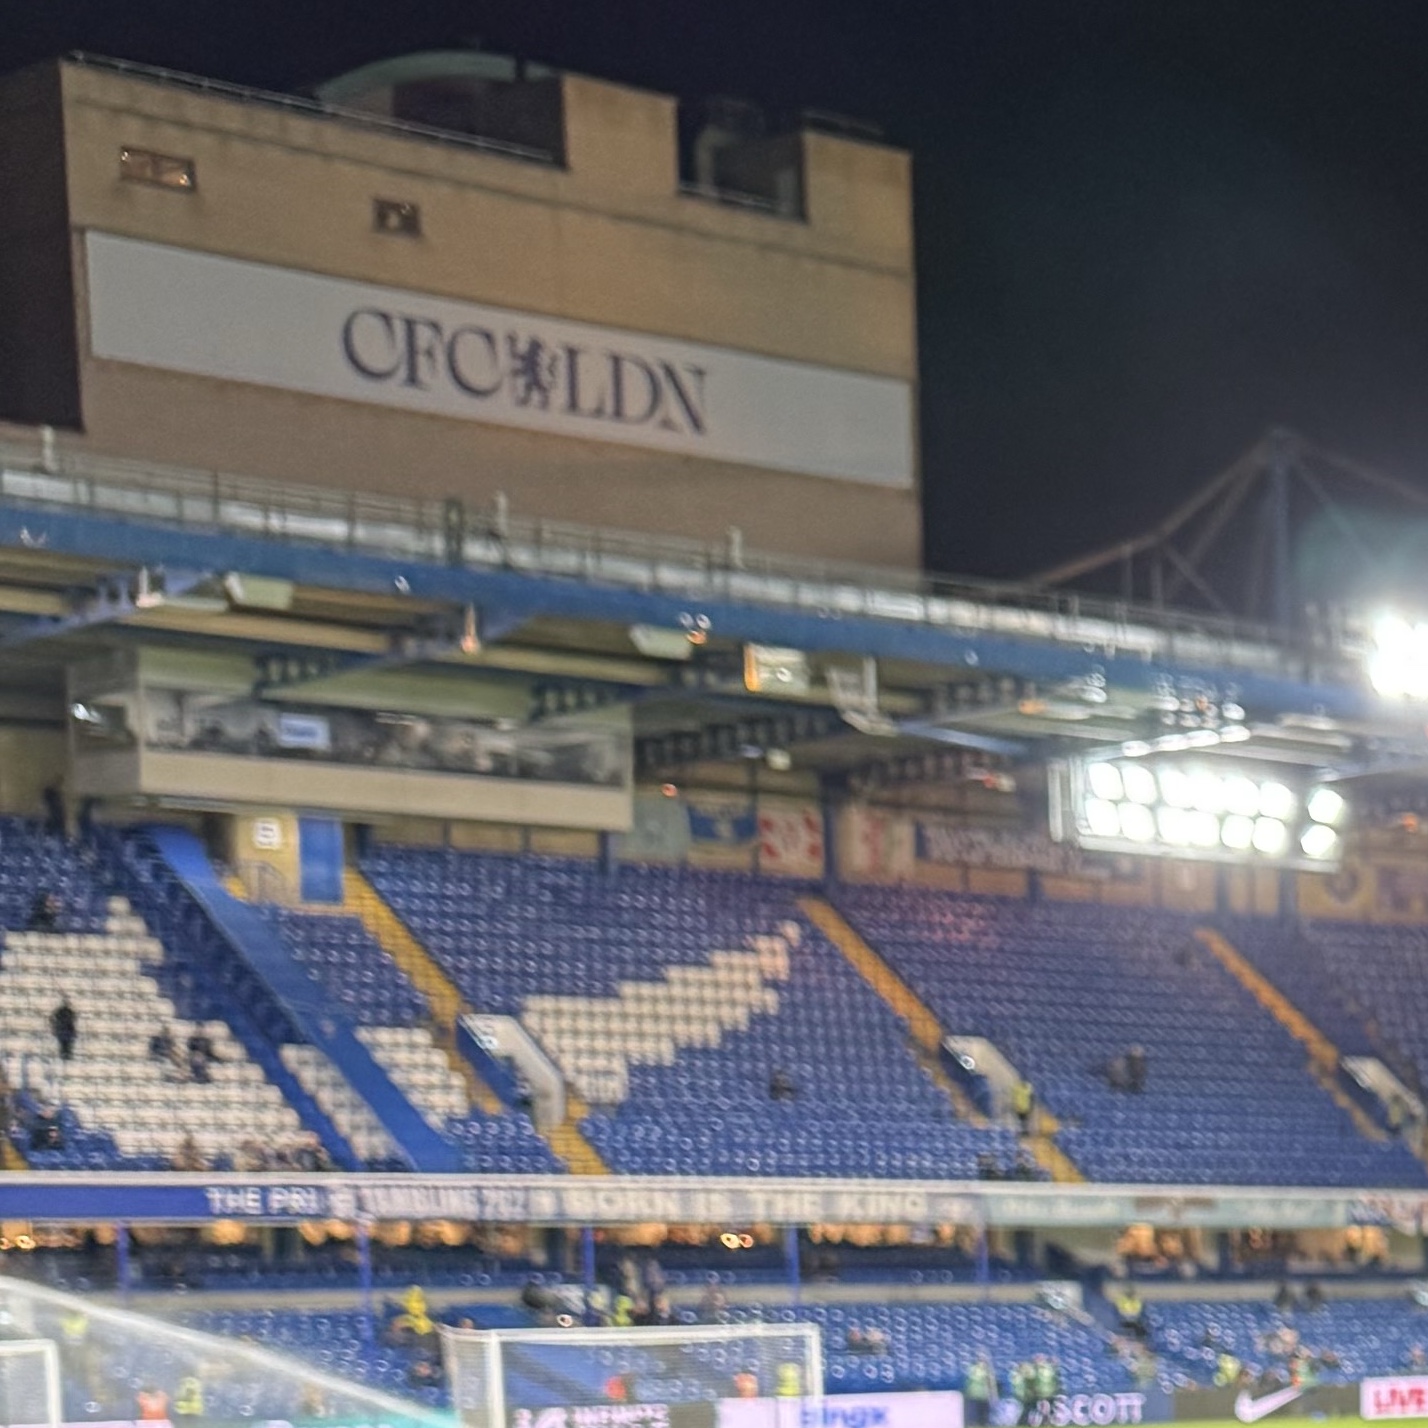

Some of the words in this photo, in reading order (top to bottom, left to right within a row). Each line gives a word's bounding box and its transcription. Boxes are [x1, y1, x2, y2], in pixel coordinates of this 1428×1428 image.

[341, 308, 501, 398] CFC
[563, 343, 708, 435] LDN
[205, 1185, 263, 1216] THE
[1373, 1387, 1425, 1412] LIVE
